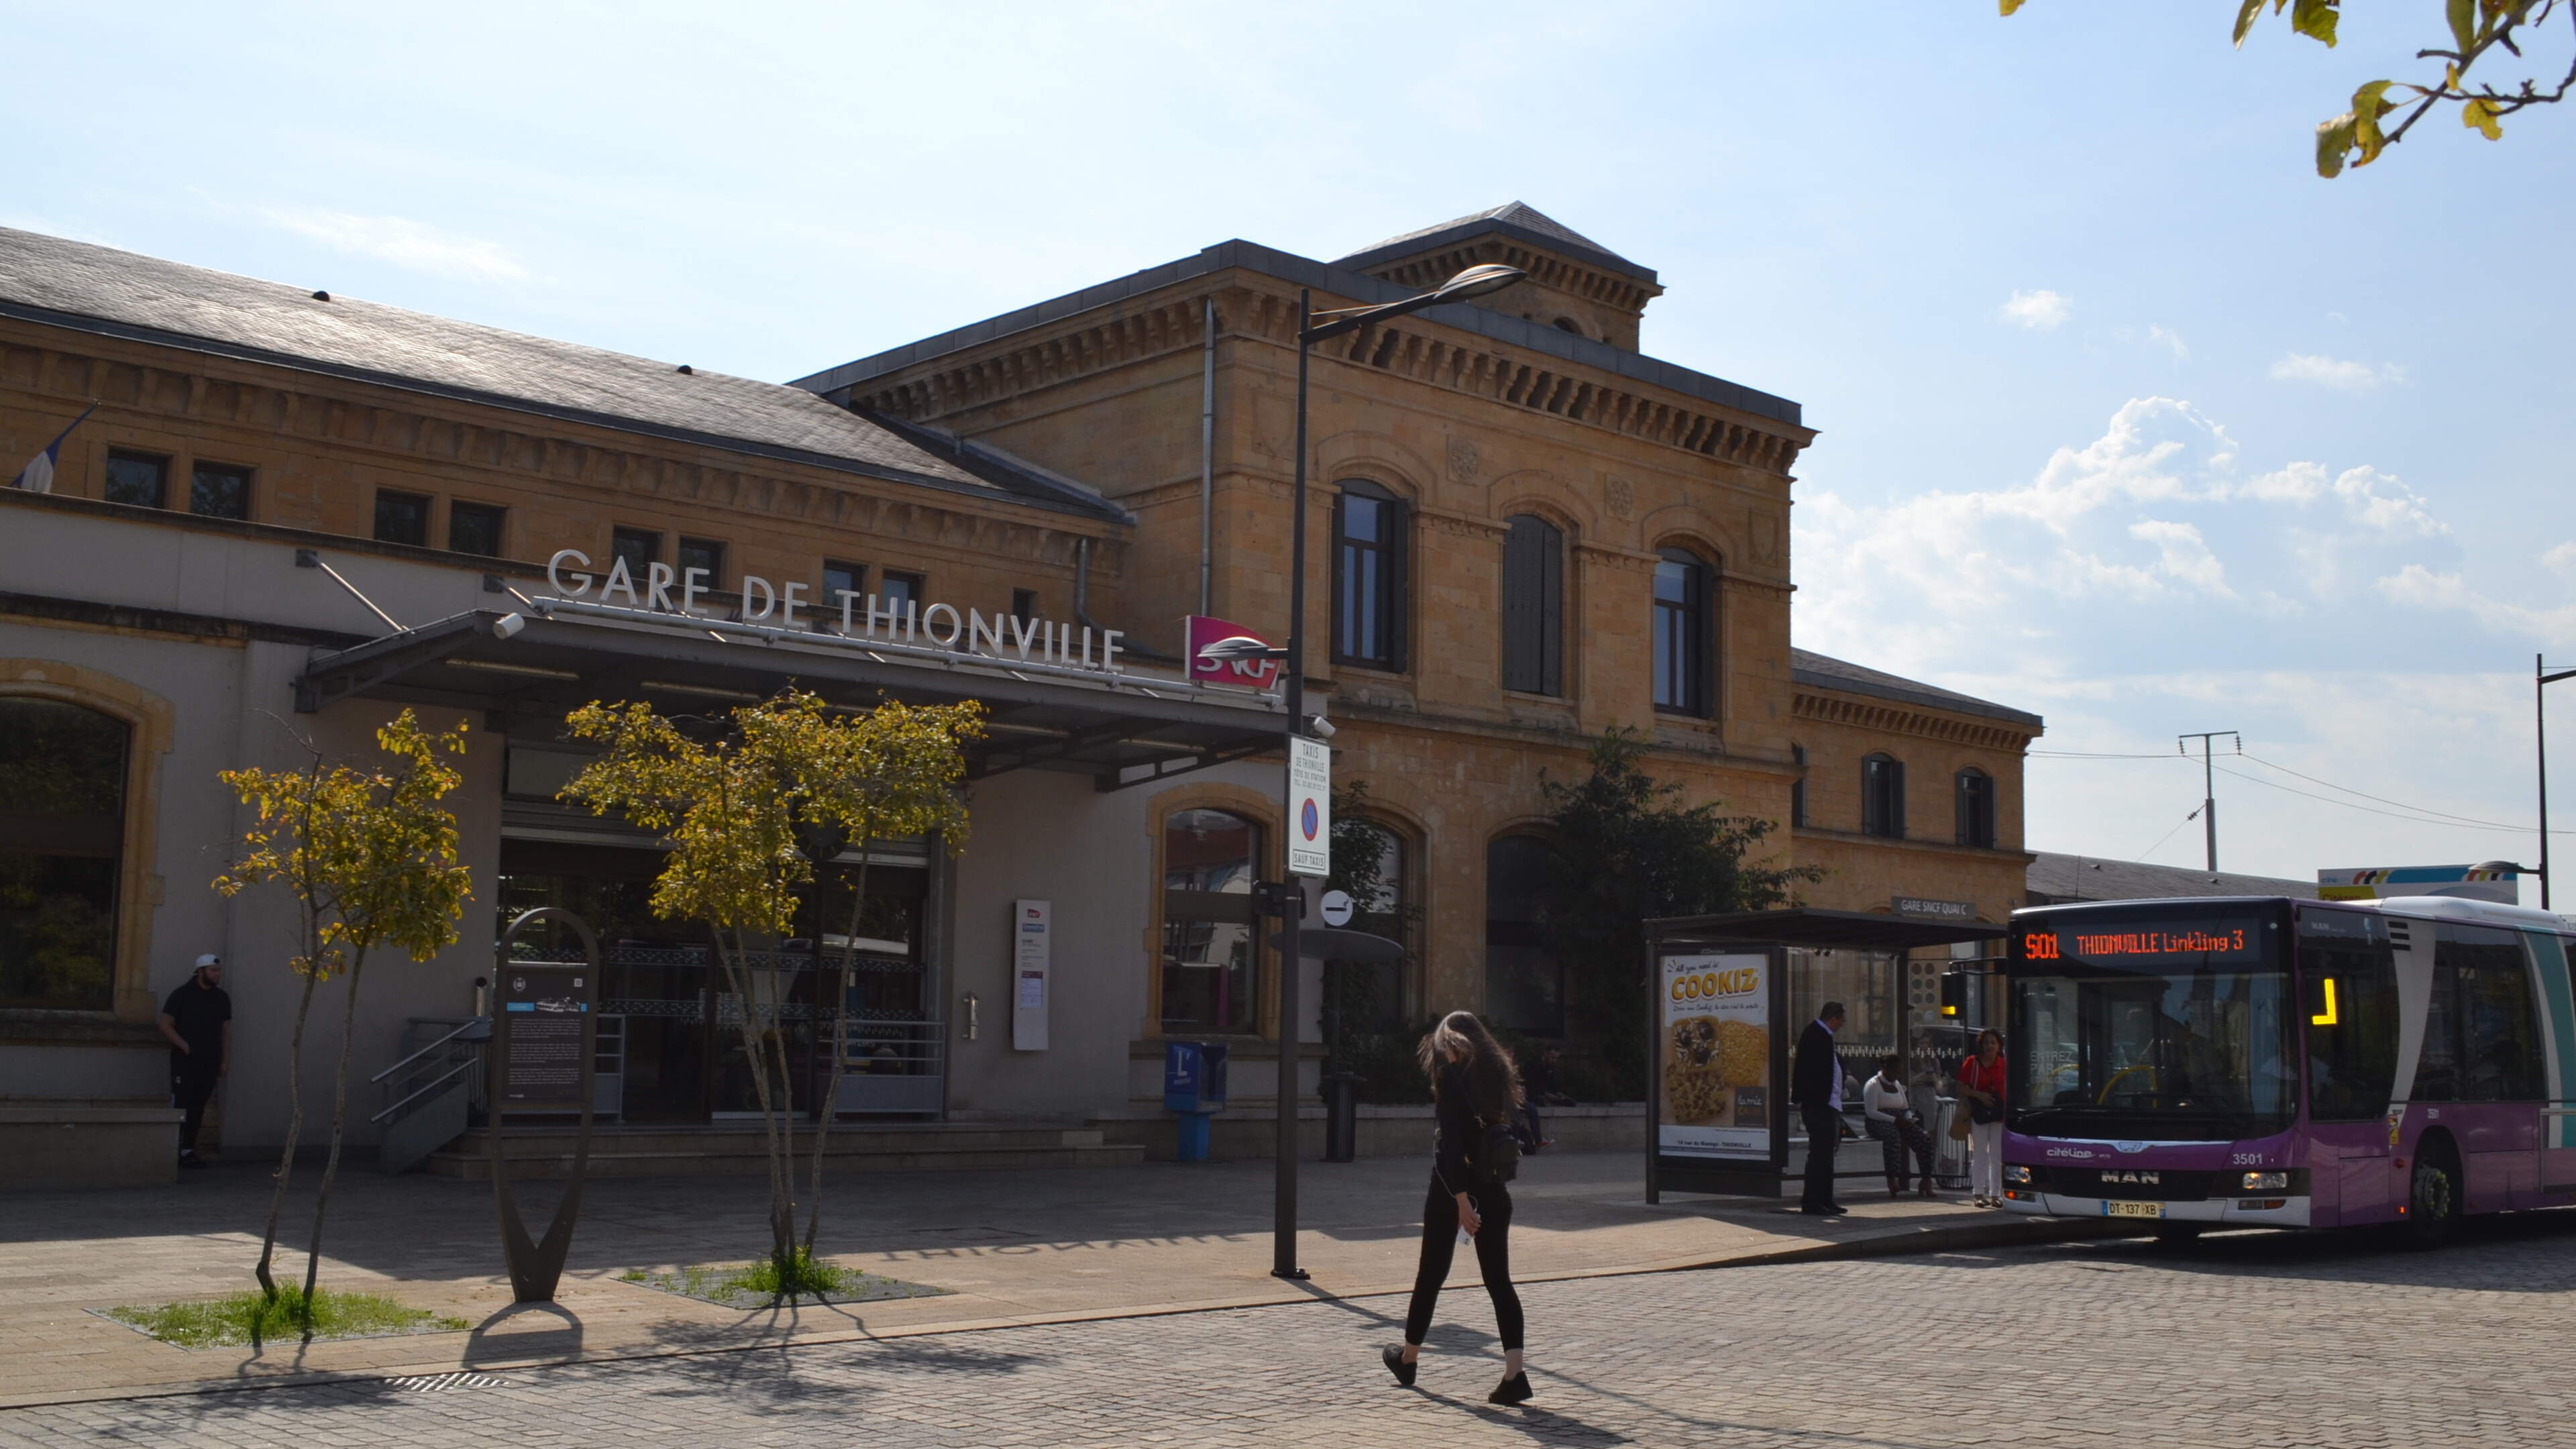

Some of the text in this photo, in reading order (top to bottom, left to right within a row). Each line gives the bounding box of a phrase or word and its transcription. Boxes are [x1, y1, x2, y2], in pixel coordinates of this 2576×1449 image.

[547, 549, 1126, 671] GARE DE THIONVILLE
[1303, 743, 1319, 759] TAXIS
[1296, 757, 1325, 772] DE THIONVILLE
[1295, 853, 1324, 867] SAUF TAXIS
[1901, 900, 1966, 915] GARE SNCF QUAI C
[2025, 934, 2059, 959] S01
[2077, 933, 2159, 956] THIONVILLE
[2233, 928, 2243, 950] 3
[1670, 967, 1759, 1001] COOKIZ
[2030, 1051, 2072, 1062] ENTREZ
[2233, 1153, 2263, 1165] 3501
[2101, 1171, 2159, 1184] MAN
